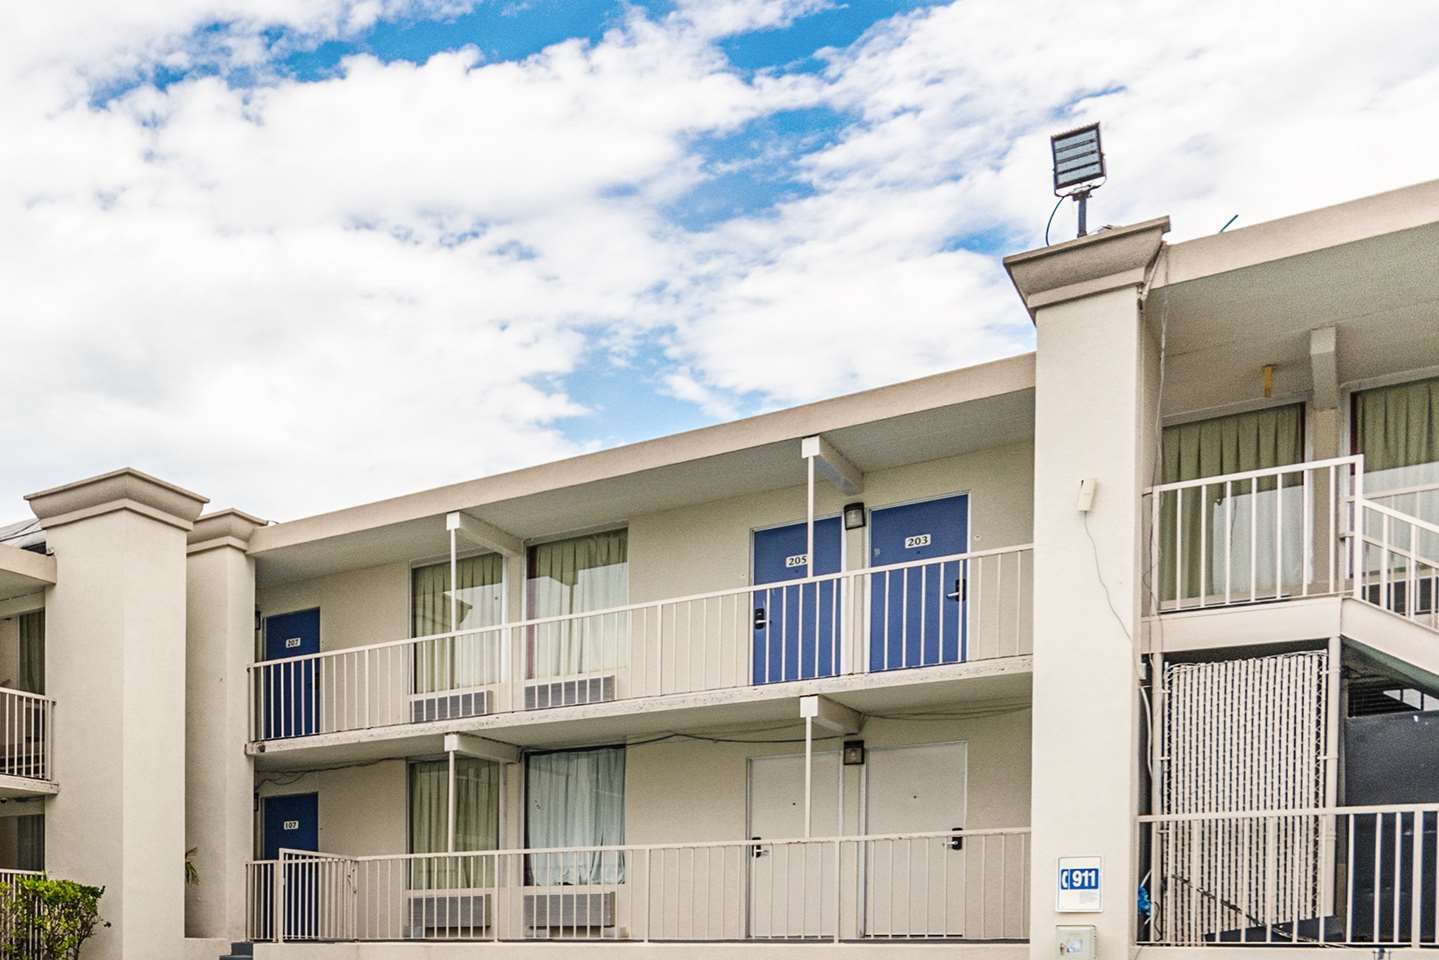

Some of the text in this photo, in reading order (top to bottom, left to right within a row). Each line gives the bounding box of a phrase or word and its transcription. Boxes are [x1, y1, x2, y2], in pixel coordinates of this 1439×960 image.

[907, 535, 929, 547] 203
[788, 555, 807, 567] 205
[284, 821, 297, 829] 107
[1072, 870, 1096, 888] 911
